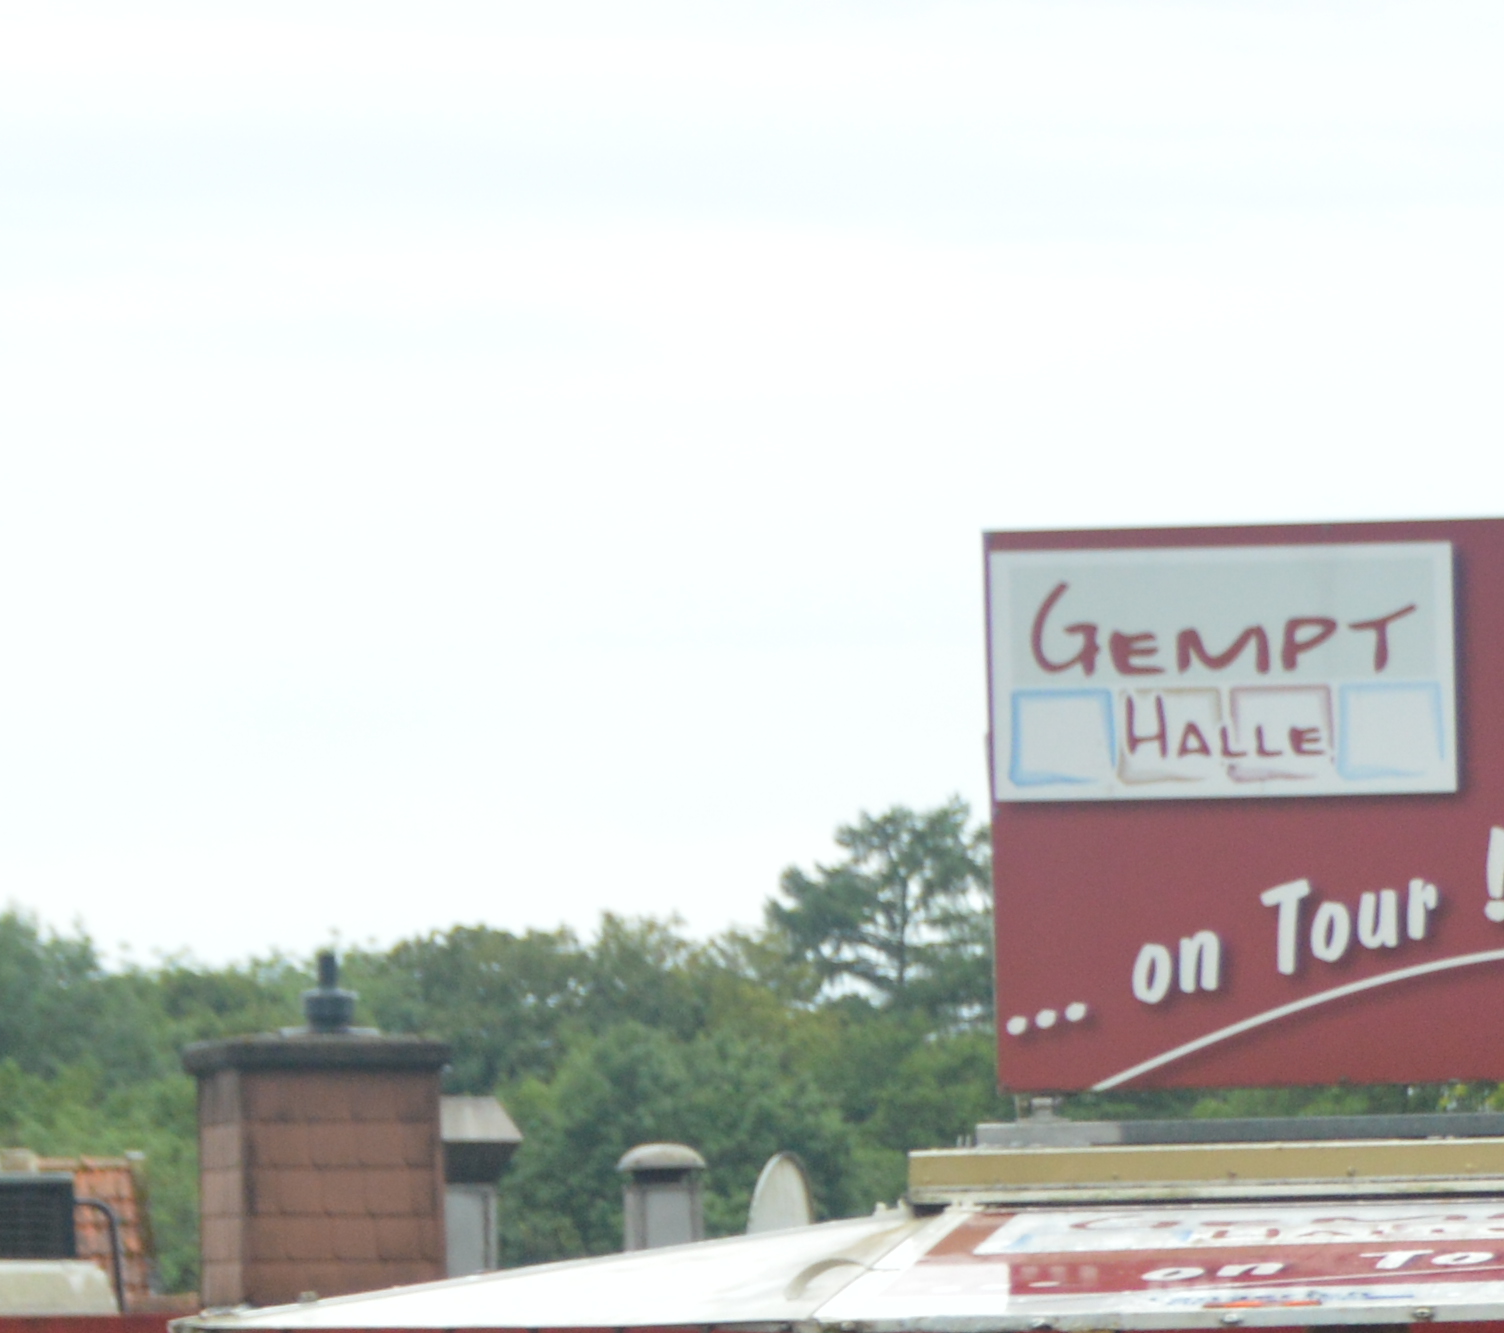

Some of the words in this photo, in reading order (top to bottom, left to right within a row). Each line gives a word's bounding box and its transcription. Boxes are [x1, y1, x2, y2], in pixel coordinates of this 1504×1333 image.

[1030, 580, 1417, 677] GEMPT
[1124, 693, 1326, 759] HALLE
[1132, 930, 1220, 1005] on
[1260, 878, 1438, 976] Tour
